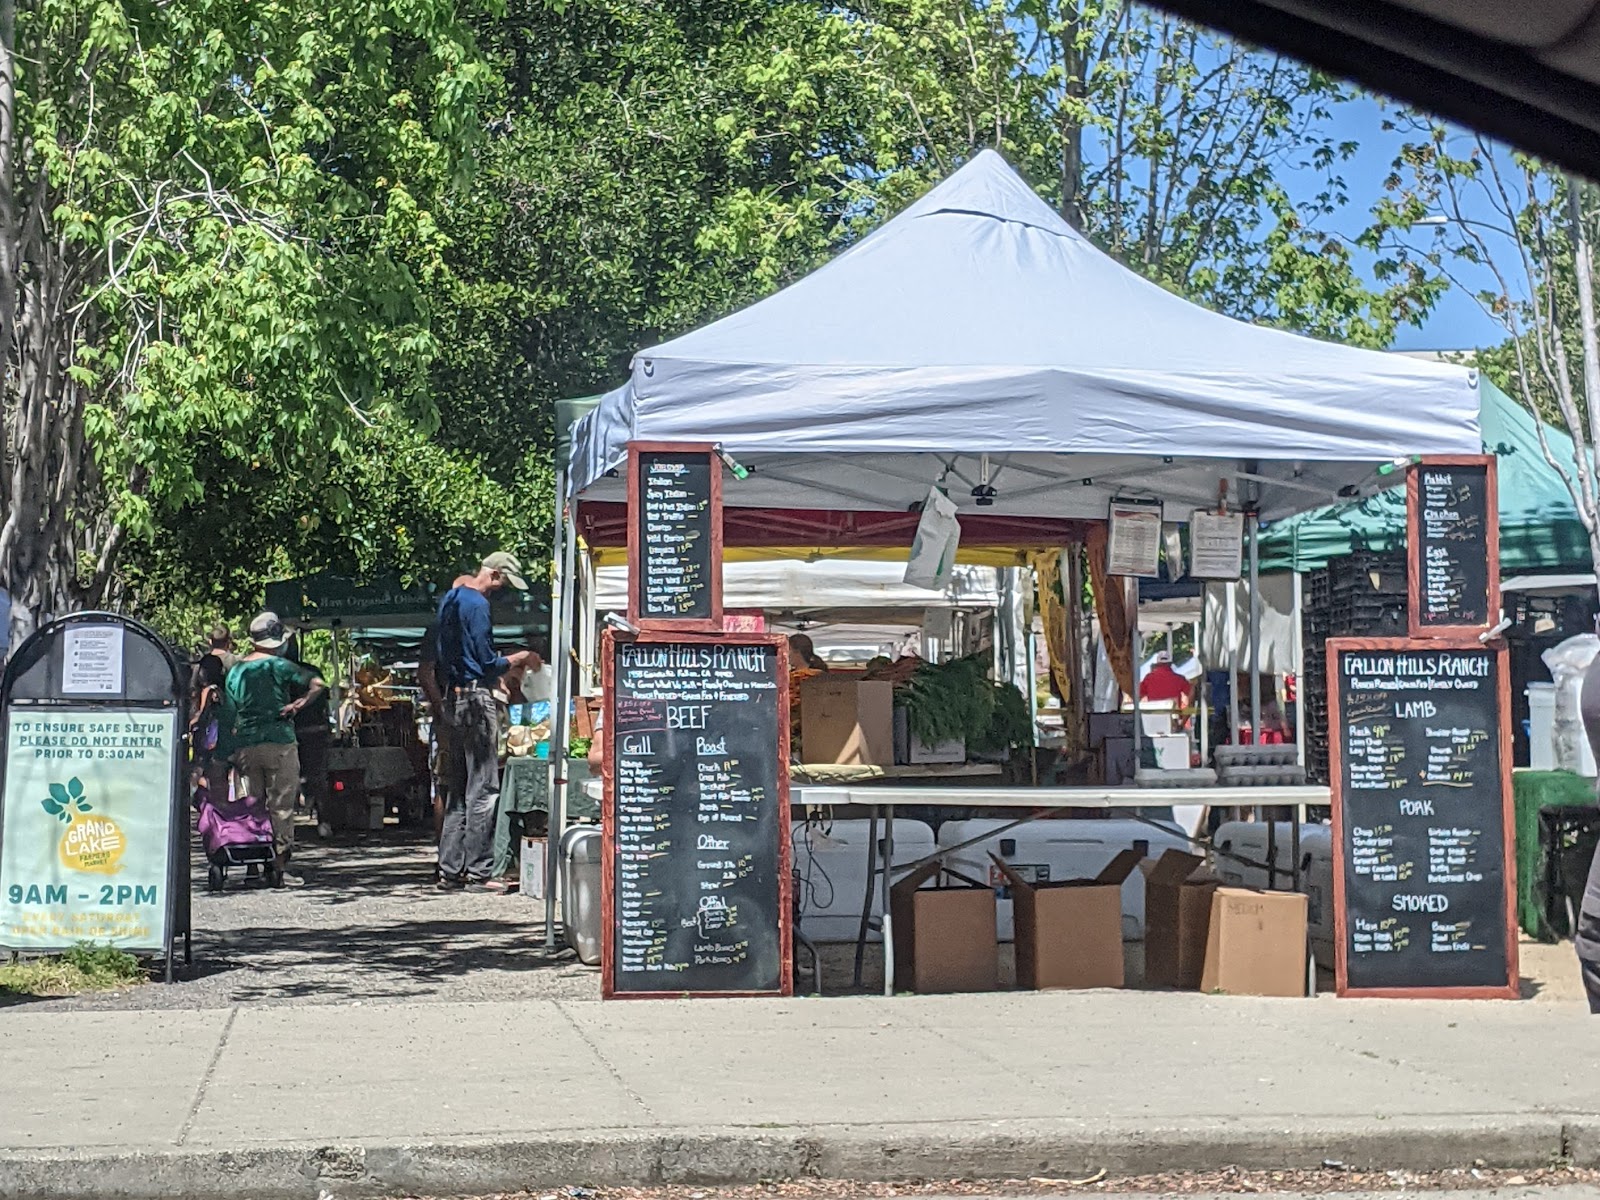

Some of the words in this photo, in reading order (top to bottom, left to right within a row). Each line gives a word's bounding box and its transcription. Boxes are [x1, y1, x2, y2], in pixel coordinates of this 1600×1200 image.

[1344, 653, 1394, 676] FALLON
[1396, 654, 1437, 676] HILLS
[1438, 653, 1489, 677] RANCH
[667, 706, 712, 729] BEEF
[1395, 700, 1437, 719] LAMB
[15, 723, 30, 732] TO
[36, 723, 85, 733] ENSURE
[90, 724, 120, 733] SAFE
[126, 724, 164, 734] SETUP
[20, 736, 66, 746] PLEASE
[72, 737, 88, 746] DO
[93, 737, 117, 746] NOT
[122, 737, 162, 747] ENTER
[36, 750, 73, 759] PRIOR
[79, 750, 93, 759] TO
[98, 750, 145, 759] 8:30AM
[68, 820, 115, 843] GRAND
[65, 836, 120, 856] LAKE
[9, 884, 68, 904] 9AM
[100, 885, 157, 905] 2PM
[1392, 894, 1449, 913] SMOKED
